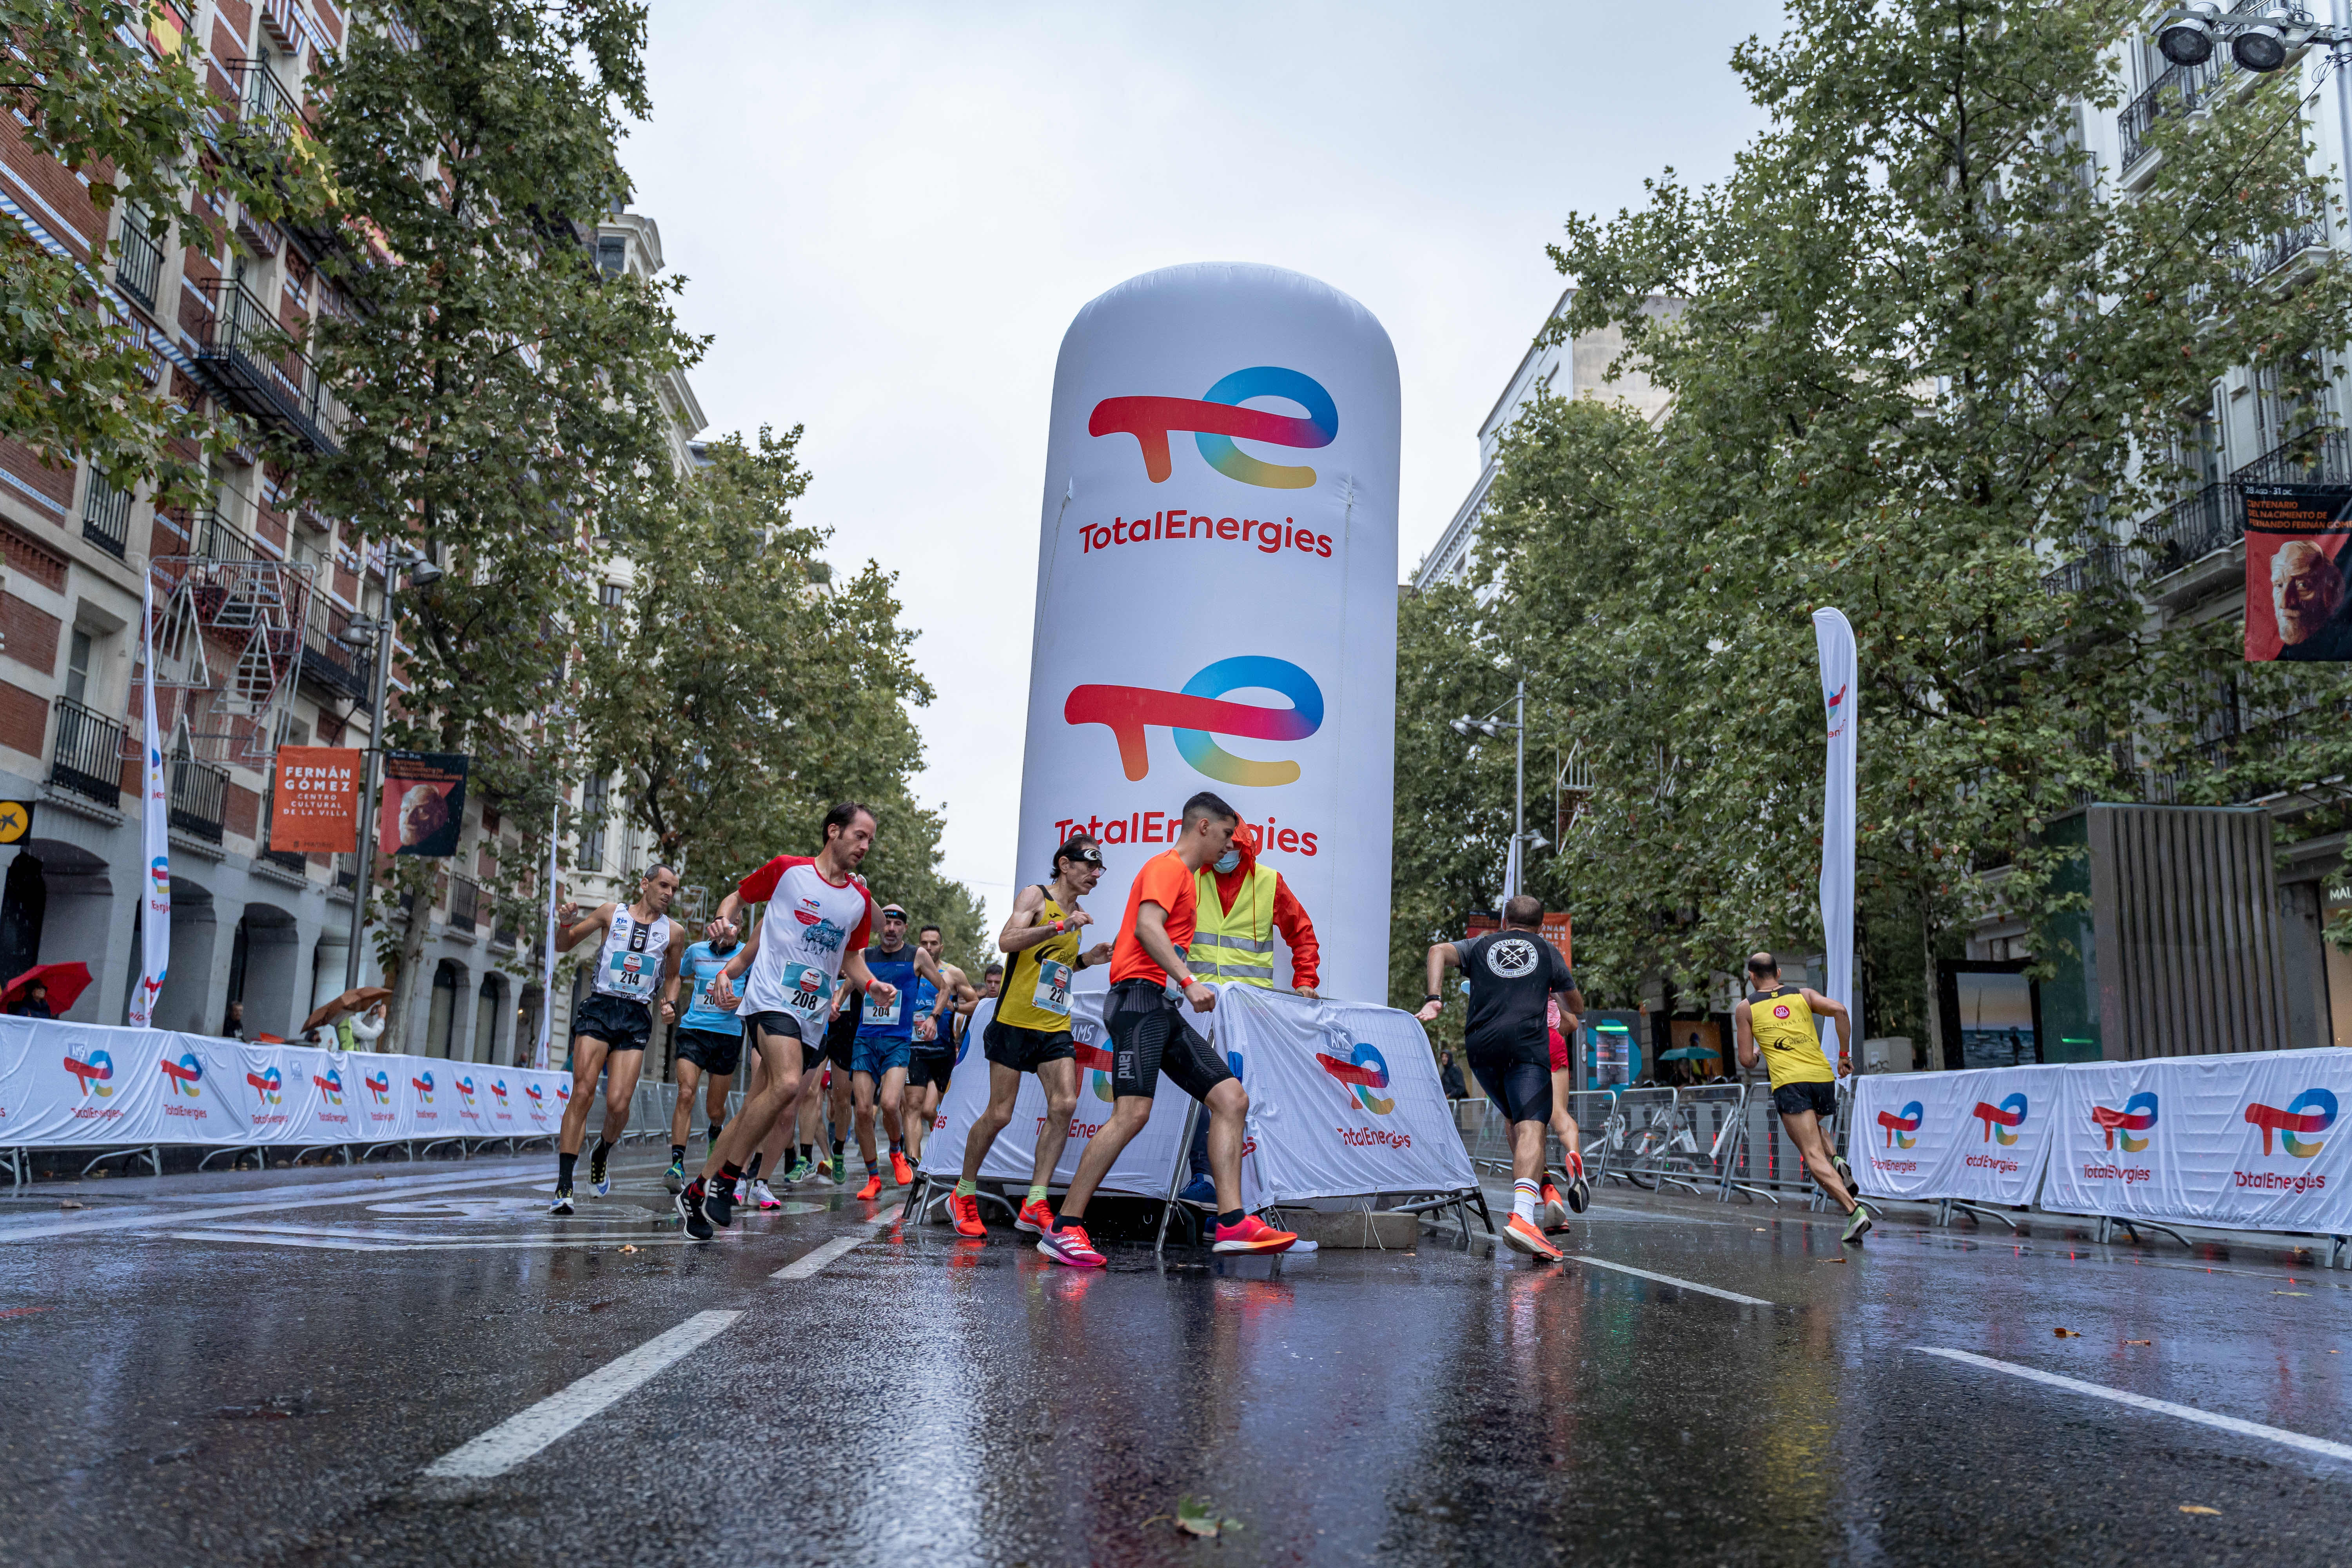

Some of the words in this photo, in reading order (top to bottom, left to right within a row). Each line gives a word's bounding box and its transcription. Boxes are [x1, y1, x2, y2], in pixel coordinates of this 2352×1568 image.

[2245, 486, 2254, 494] 28
[2260, 510, 2315, 519] NACIMIENTO
[2249, 518, 2290, 528] FENANDO
[2292, 519, 2326, 529] FERNÁN
[1079, 510, 1333, 559] TotalEnergies
[285, 765, 351, 779] FERNÁN
[285, 777, 350, 792] GÓMEZ
[1054, 811, 1318, 857] TotalEngies
[1539, 931, 1566, 940] ÓMEZ
[1492, 940, 1517, 950] RUNNING
[1519, 940, 1535, 953] PUNKS
[620, 971, 640, 986] 214
[703, 995, 715, 1005] 20
[790, 990, 818, 1010] 208
[873, 1006, 890, 1017] 204
